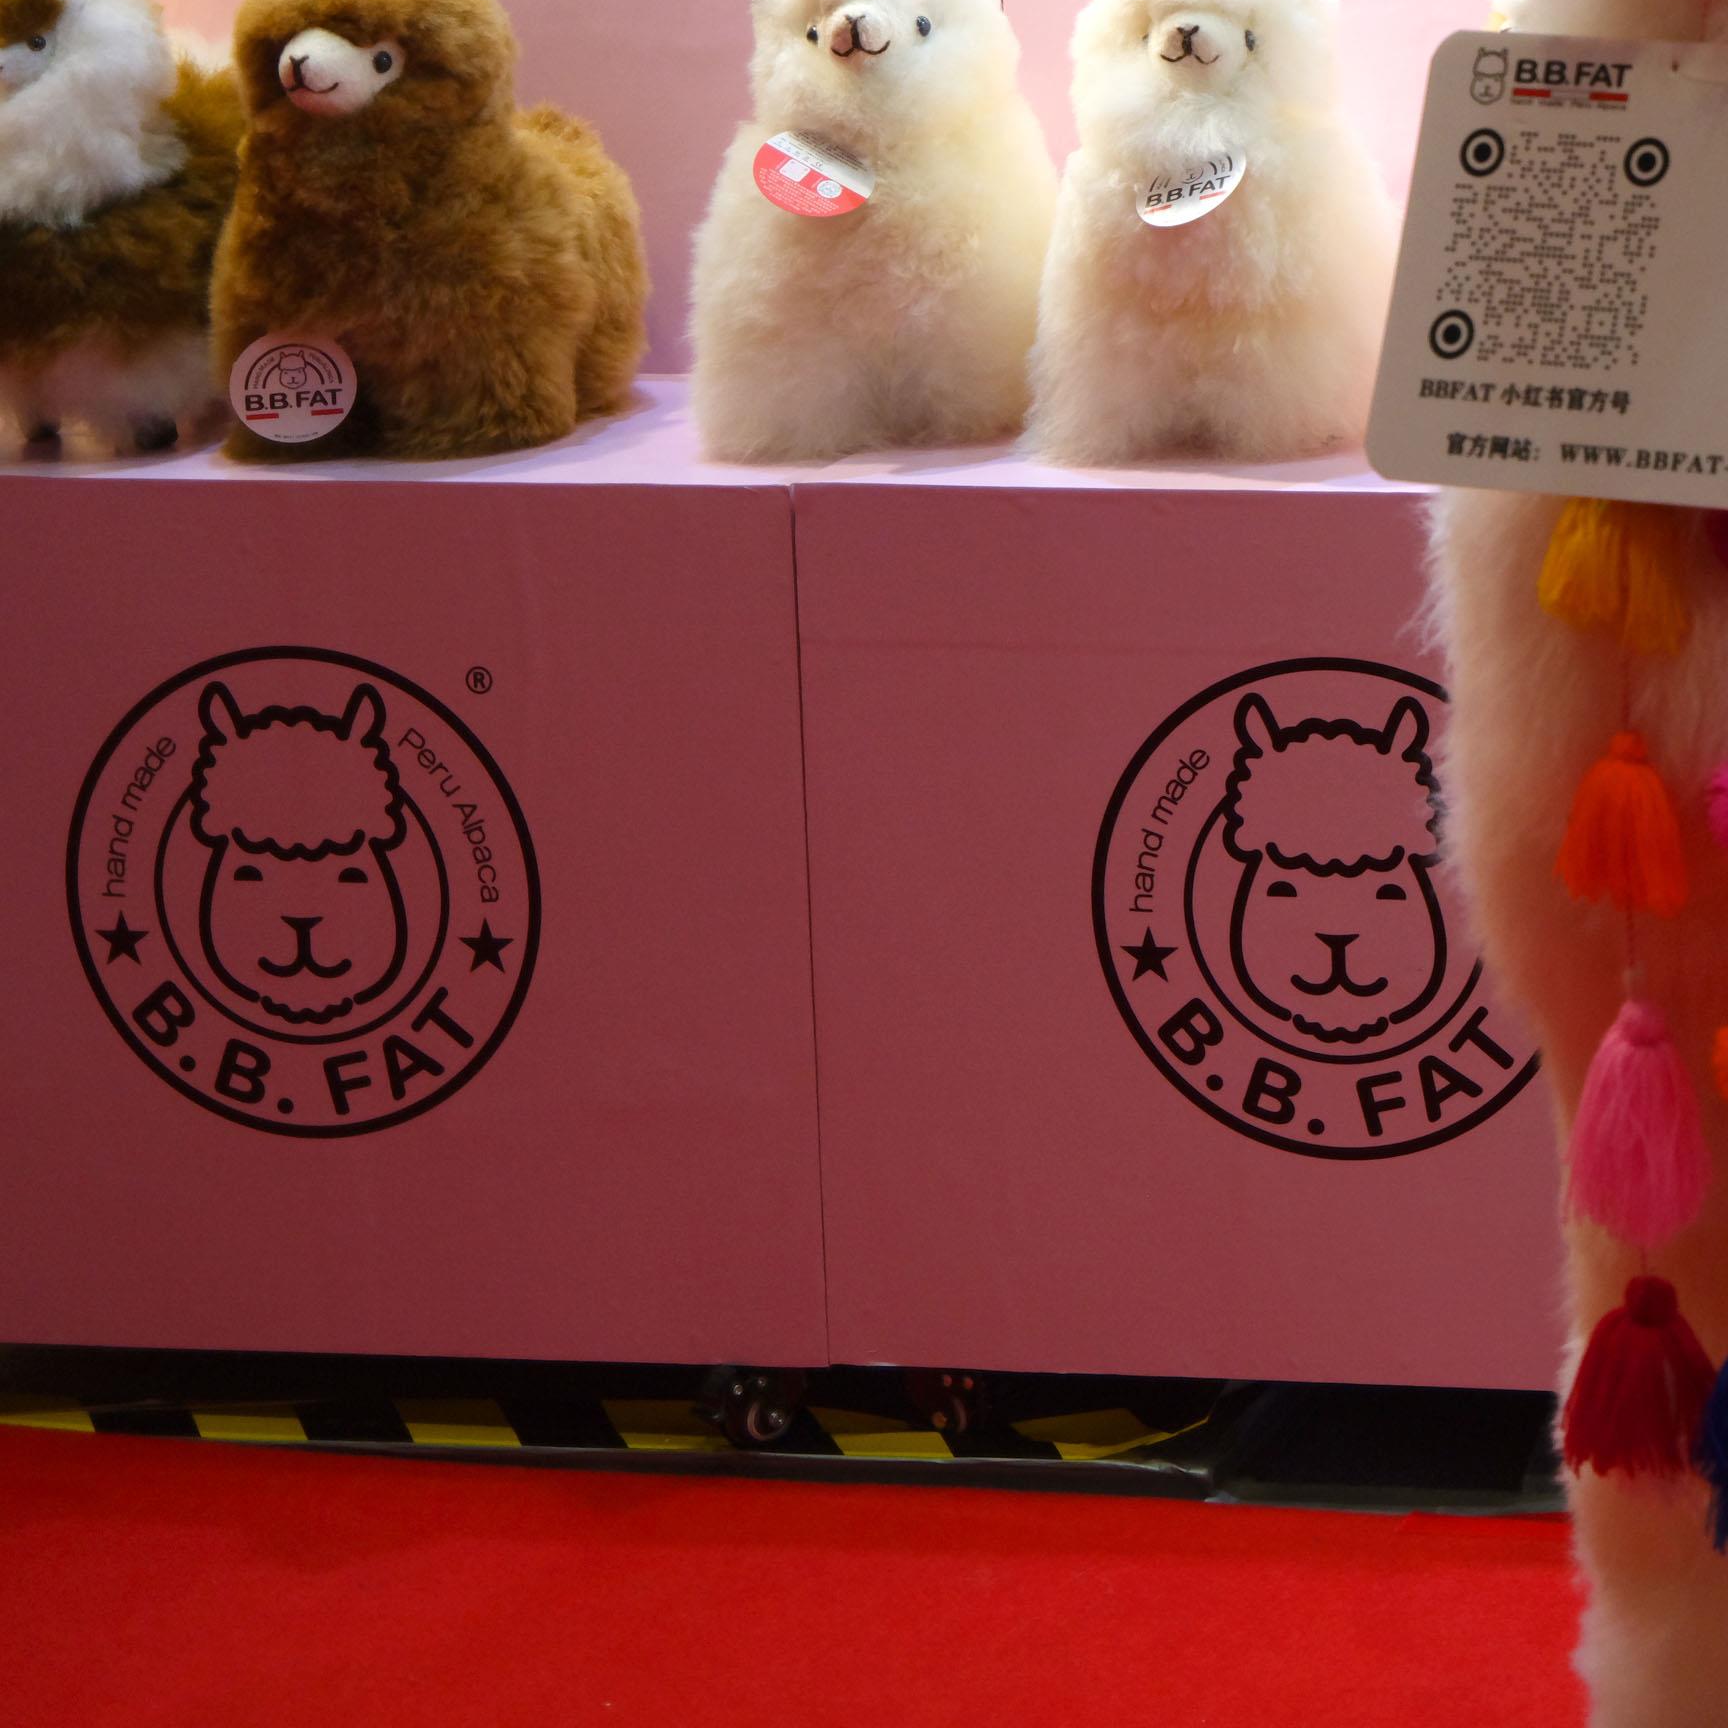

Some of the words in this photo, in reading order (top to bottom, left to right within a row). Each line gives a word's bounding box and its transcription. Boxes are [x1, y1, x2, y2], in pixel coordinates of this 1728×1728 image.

[1514, 59, 1633, 88] B.B.FAT
[1145, 175, 1231, 208] B.B.FAT
[245, 388, 343, 411] B.B.FAT
[1418, 377, 1497, 403] BBFAT
[1501, 383, 1631, 415] 小红书官方号
[101, 815, 135, 899] hand
[120, 734, 178, 812] made
[397, 726, 461, 797] Peru
[451, 802, 500, 905] Alpaca
[1129, 827, 1164, 915] hand
[1151, 747, 1211, 826] made
[131, 979, 475, 1116] B.B.FAT
[1157, 997, 1516, 1138] B.B.FAT
